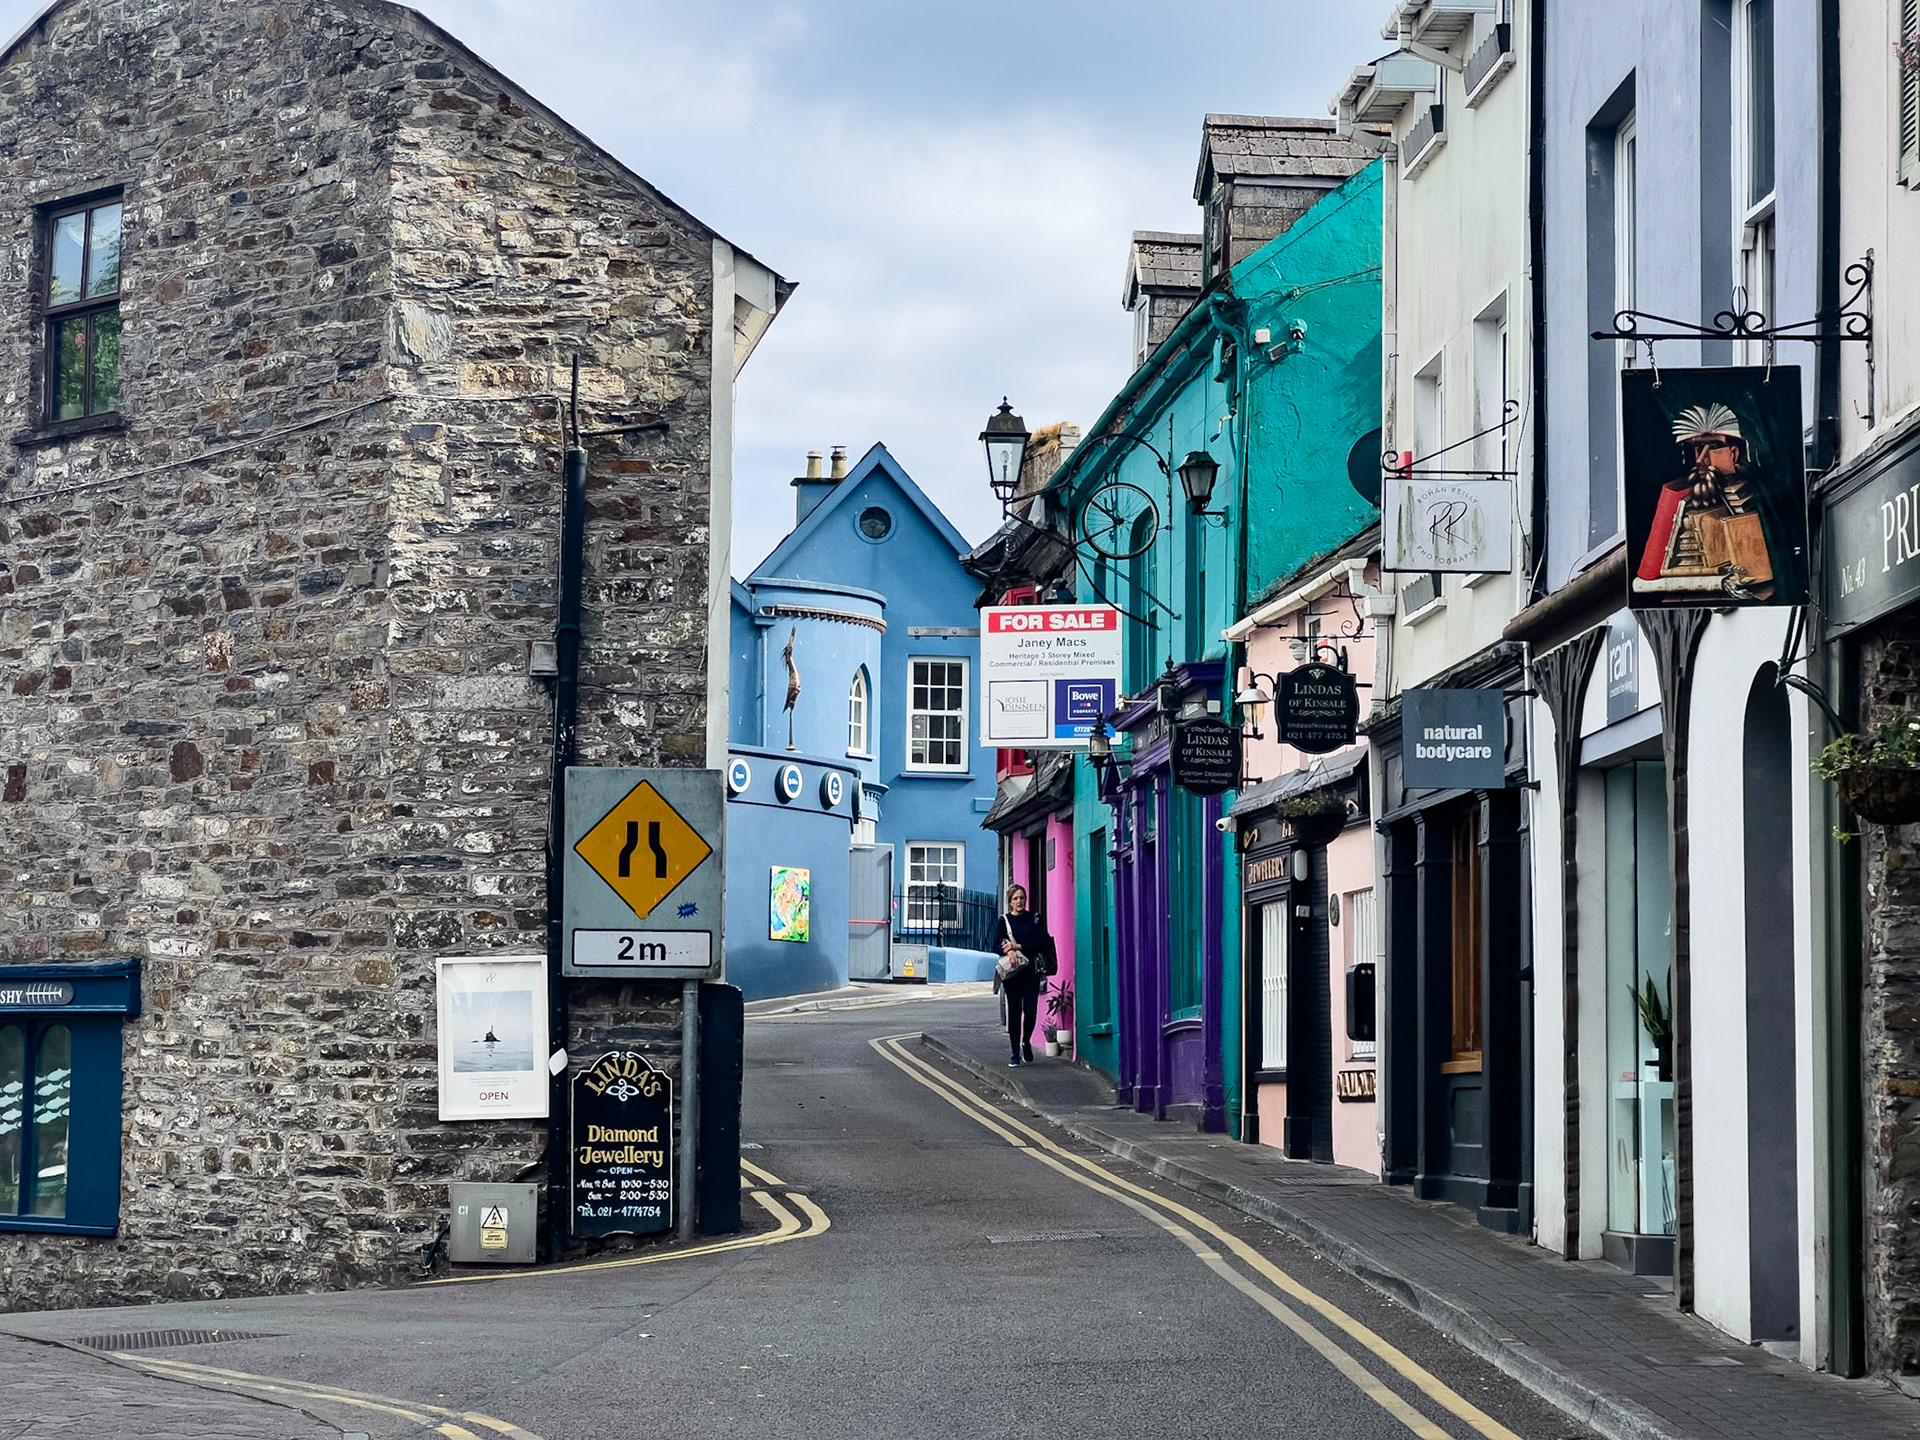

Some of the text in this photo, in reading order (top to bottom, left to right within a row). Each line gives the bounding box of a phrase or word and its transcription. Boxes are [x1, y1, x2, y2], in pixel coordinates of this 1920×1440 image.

[1416, 486, 1479, 504] ROHAN REILLY
[1416, 545, 1479, 565] PHOTOGRAPHY
[1855, 557, 1866, 588] 43
[1000, 613, 1105, 631] FOR SALE
[1017, 637, 1087, 651] Janey Macs
[1009, 652, 1040, 660] Heritage
[1048, 652, 1071, 660] Storey
[1609, 631, 1633, 683] rain
[989, 660, 1033, 668] Commercial
[1038, 659, 1080, 667] Residential
[1072, 691, 1099, 700] Bowe
[1294, 683, 1342, 695] LINDAS
[1005, 703, 1046, 711] DINNEEN
[1304, 698, 1347, 708] KINSALE
[1187, 733, 1229, 745] LINDAS
[1424, 724, 1483, 740] natural
[1196, 747, 1233, 757] KINSALE
[1416, 744, 1492, 762] bodycare
[584, 1057, 662, 1097] LINDA'S
[479, 1092, 509, 1101] OPEN
[587, 1125, 659, 1143] Diamond
[579, 1145, 664, 1168] Jewellery
[609, 1167, 633, 1175] OPEN
